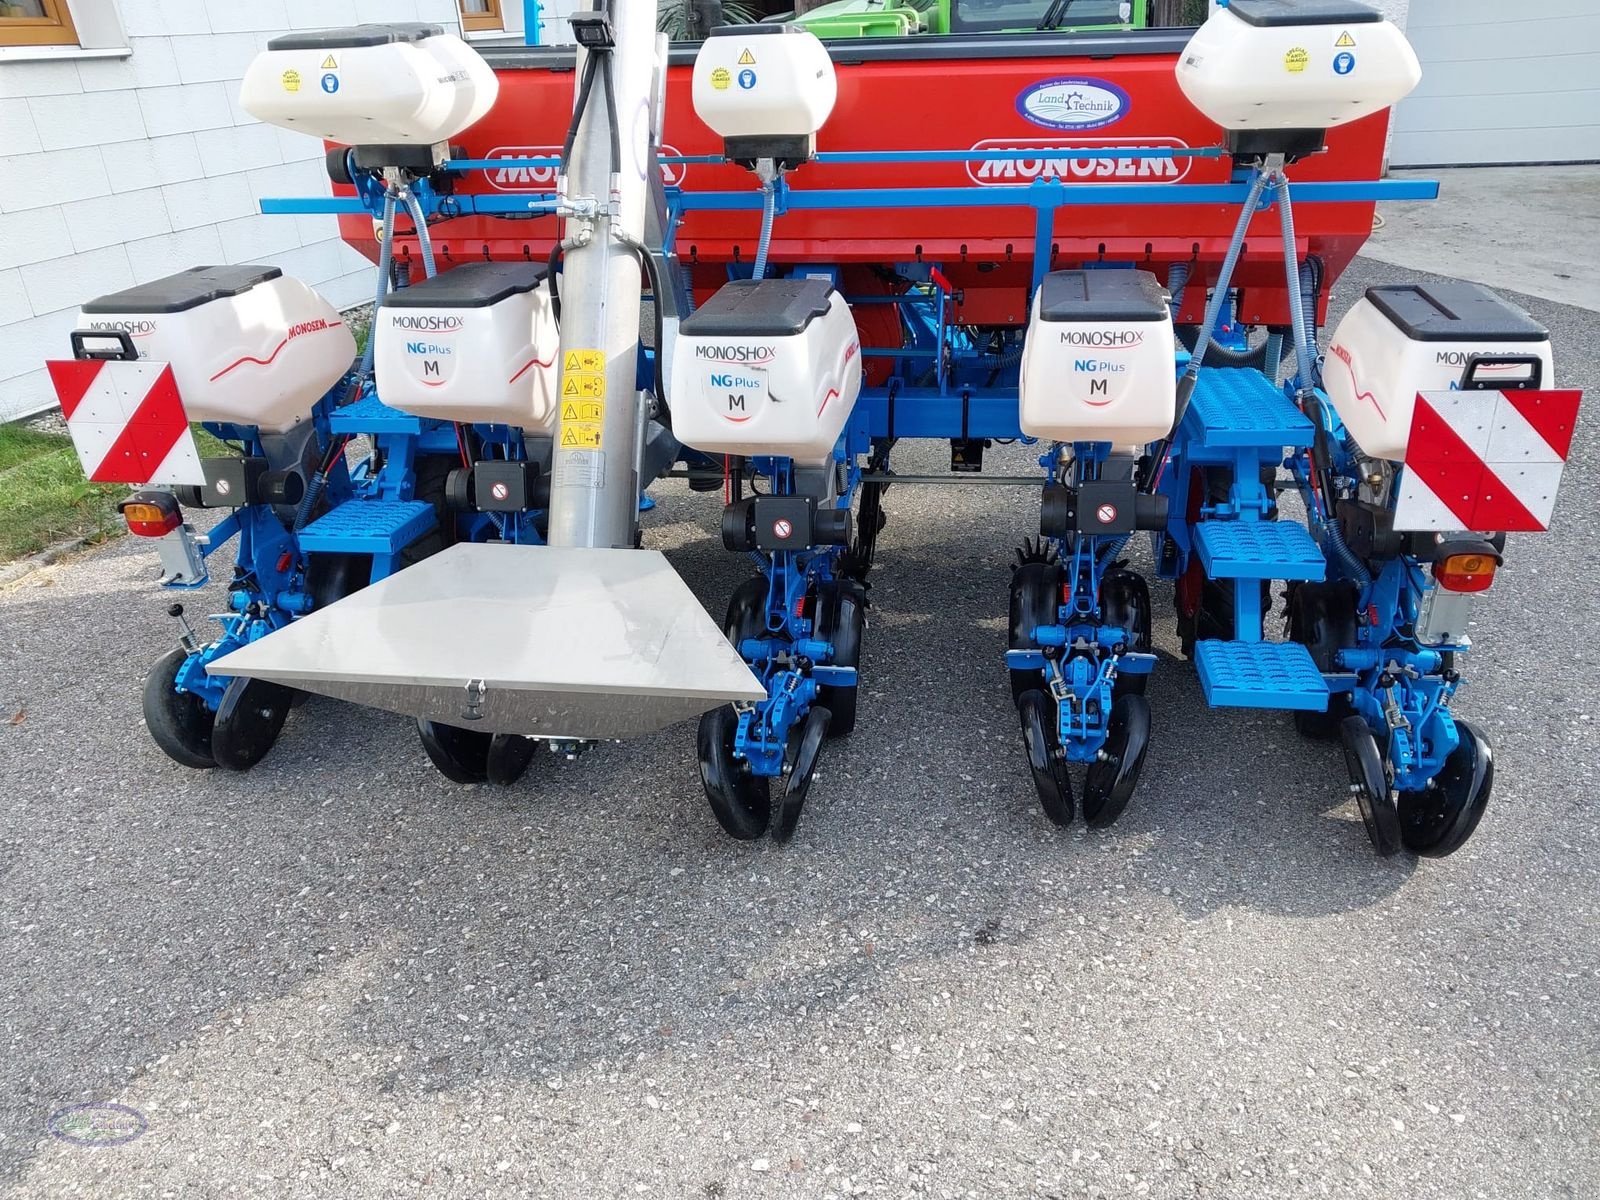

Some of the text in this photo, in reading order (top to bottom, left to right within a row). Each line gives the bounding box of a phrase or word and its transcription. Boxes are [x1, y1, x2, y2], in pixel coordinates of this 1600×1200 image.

[1038, 92, 1113, 112] Land Technik
[977, 146, 1179, 177] MONOSEM
[288, 318, 328, 340] MONOSEM
[392, 315, 465, 330] MONOSHOX
[1060, 330, 1144, 346] MONOSHOX
[406, 342, 452, 355] NG Plus
[695, 345, 776, 361] MONOSHOX
[424, 360, 440, 376] M
[1074, 359, 1126, 372] NG Plus
[711, 374, 760, 388] NG Plus
[1090, 378, 1108, 395] M
[728, 394, 745, 411] M
